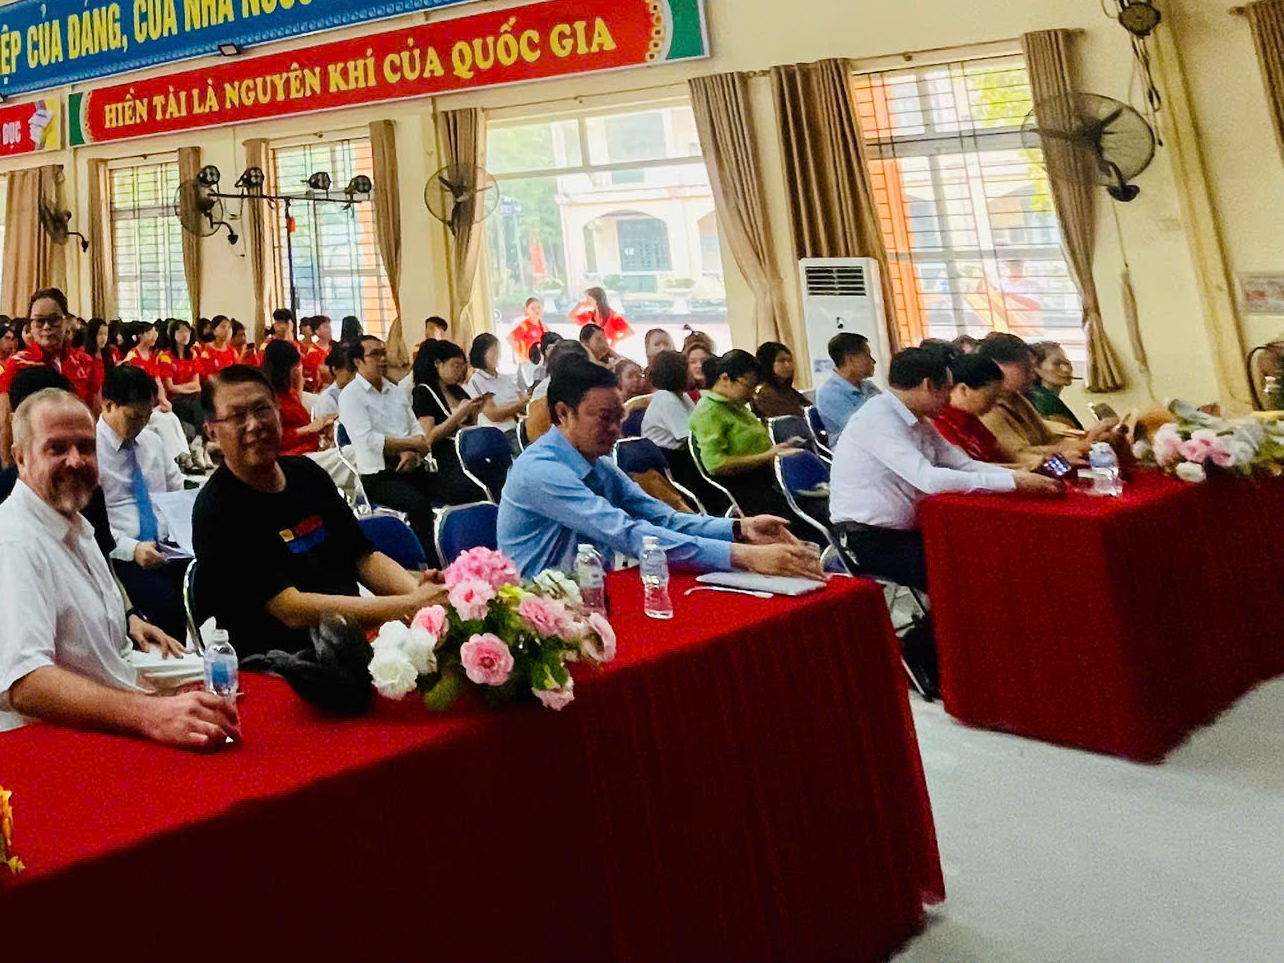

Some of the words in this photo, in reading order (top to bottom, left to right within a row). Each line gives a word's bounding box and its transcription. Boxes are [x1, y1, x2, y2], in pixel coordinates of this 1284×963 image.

[26, 4, 62, 69] CỦA
[104, 88, 148, 129] HIỀN
[152, 85, 186, 120] TÀI
[192, 78, 220, 115] LÀ
[224, 62, 321, 109] NGUYÊN
[327, 48, 377, 93] KHÍ
[383, 37, 444, 84] CỦA
[451, 16, 541, 80] QUỐC
[549, 17, 616, 58] GIA
[2, 120, 21, 149] DỤC
